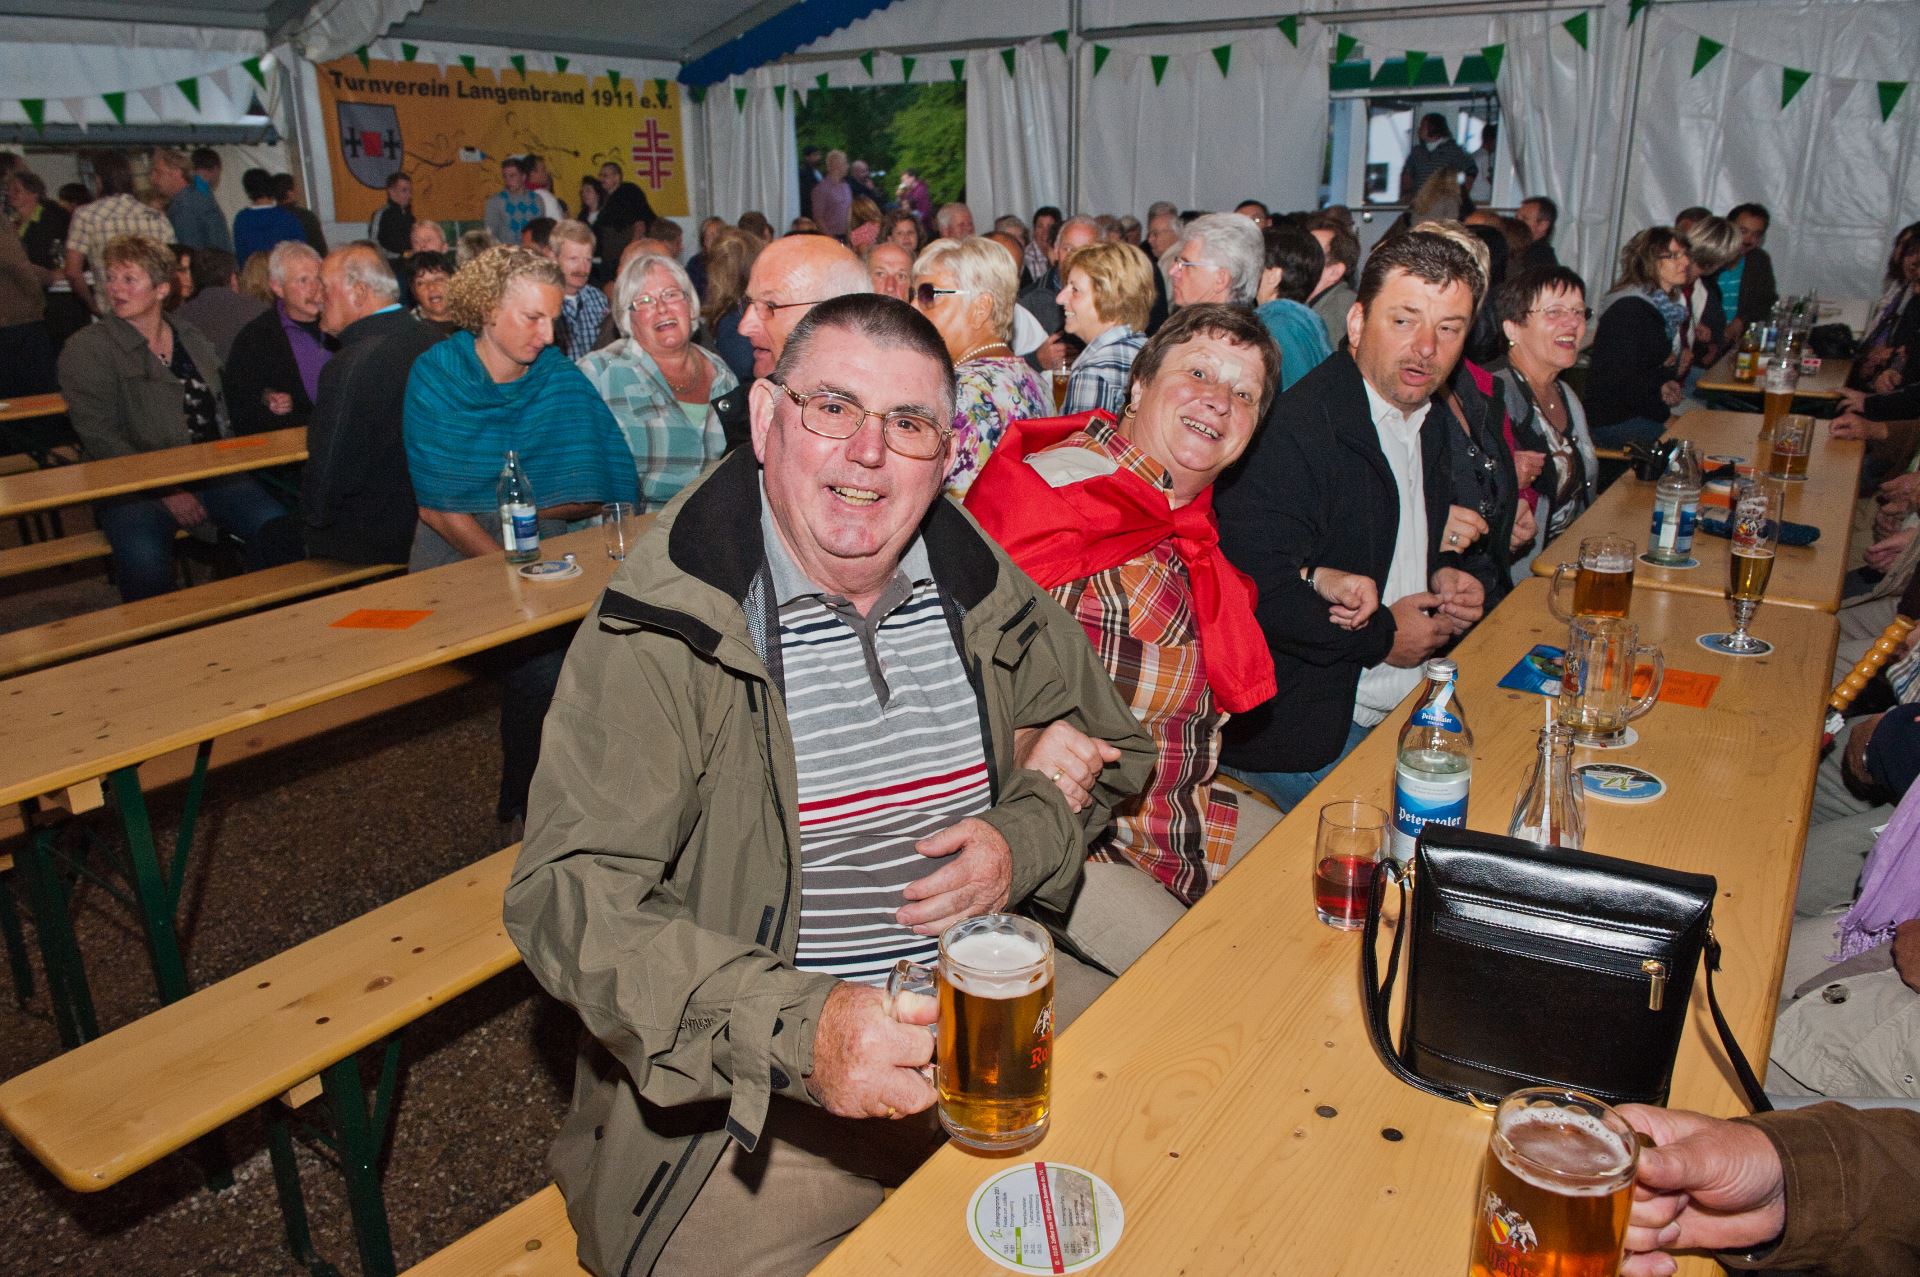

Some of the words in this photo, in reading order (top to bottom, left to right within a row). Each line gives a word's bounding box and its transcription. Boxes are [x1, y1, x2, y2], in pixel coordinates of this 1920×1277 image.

[329, 69, 450, 98] Turnverein
[457, 80, 584, 105] Langenbrand
[591, 90, 634, 108] 1911
